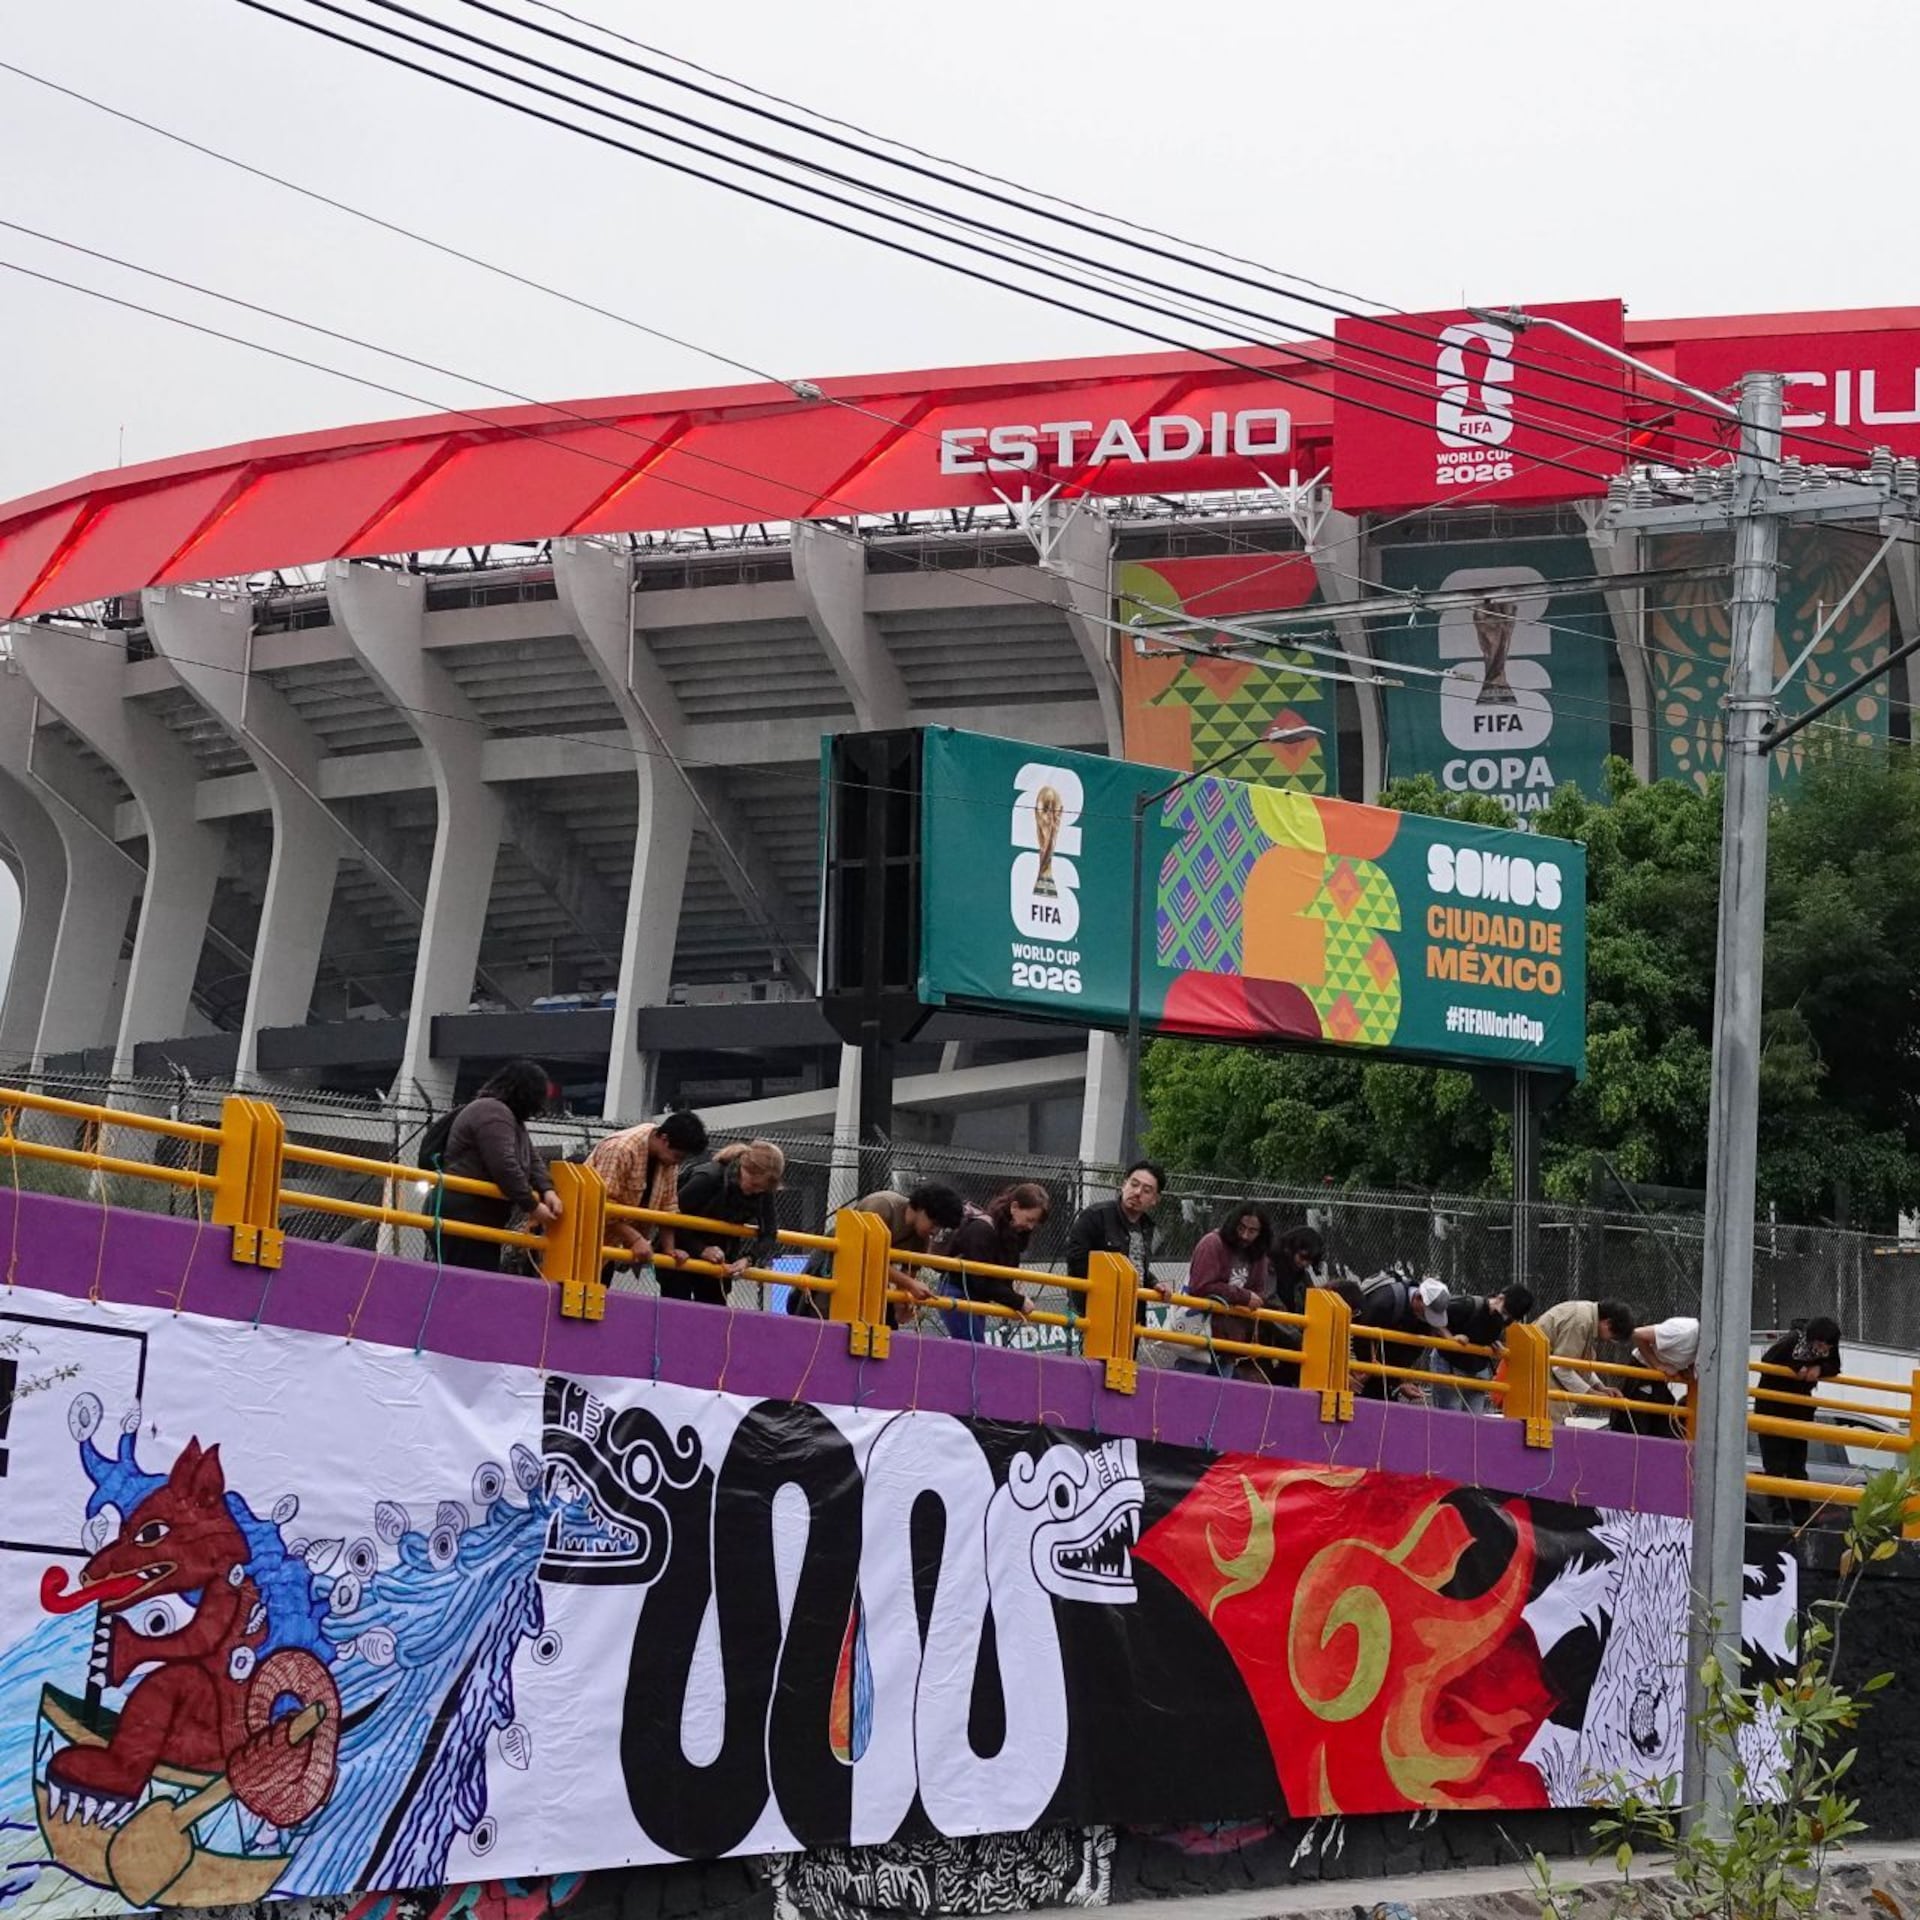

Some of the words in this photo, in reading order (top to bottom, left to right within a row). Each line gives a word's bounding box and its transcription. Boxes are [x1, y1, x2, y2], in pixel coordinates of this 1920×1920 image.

[941, 408, 1291, 475] ESTADIO
[1459, 421, 1493, 435] FIFA
[1436, 450, 1485, 465] WORLD
[1486, 449, 1514, 463] CUP
[1436, 462, 1514, 485] 2026
[1473, 713, 1524, 734] FIFA
[1442, 756, 1556, 792] COPA
[1427, 843, 1562, 910] SOMOS
[1031, 904, 1062, 925] FIFA
[1427, 904, 1526, 950] CIUDAD
[1529, 920, 1563, 956] DE
[1011, 942, 1055, 963] WORLD
[1056, 948, 1081, 966] CUP
[1426, 942, 1562, 995] MÉXICO
[1011, 961, 1083, 994] 2026
[1446, 1005, 1545, 1046] #FIFAWorldCup
